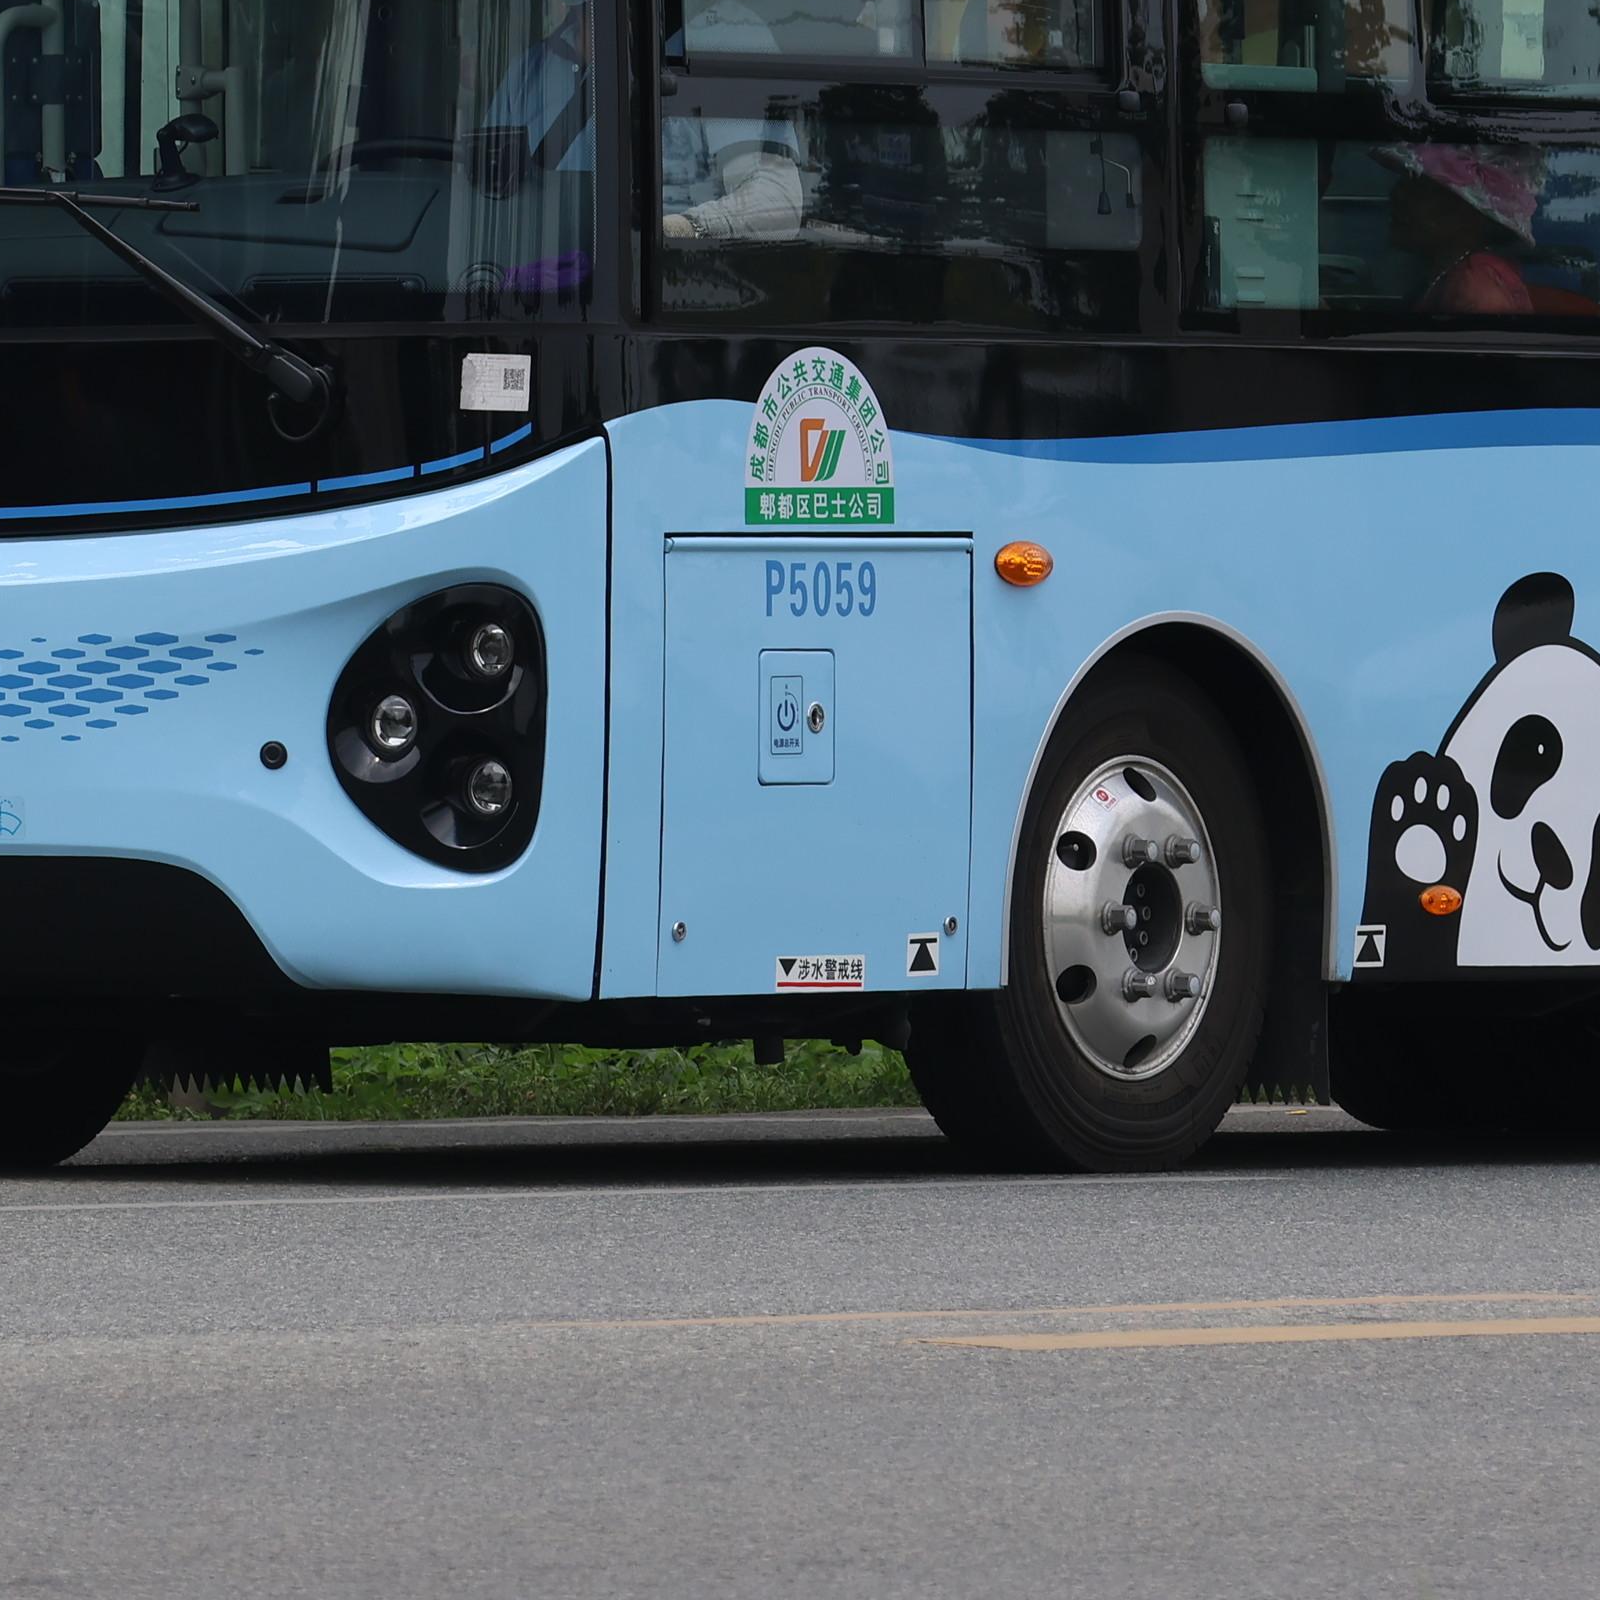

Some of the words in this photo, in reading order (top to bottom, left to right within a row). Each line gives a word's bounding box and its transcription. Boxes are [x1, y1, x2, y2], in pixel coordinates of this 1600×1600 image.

[781, 387, 807, 420] PUBLIC
[808, 386, 851, 413] TRANSPORT
[750, 356, 890, 485] 成都市公共交通集团公司
[759, 492, 882, 520] 郫都区巴士公司
[765, 559, 877, 617] P5059
[797, 957, 864, 981] 涉水警戒线
